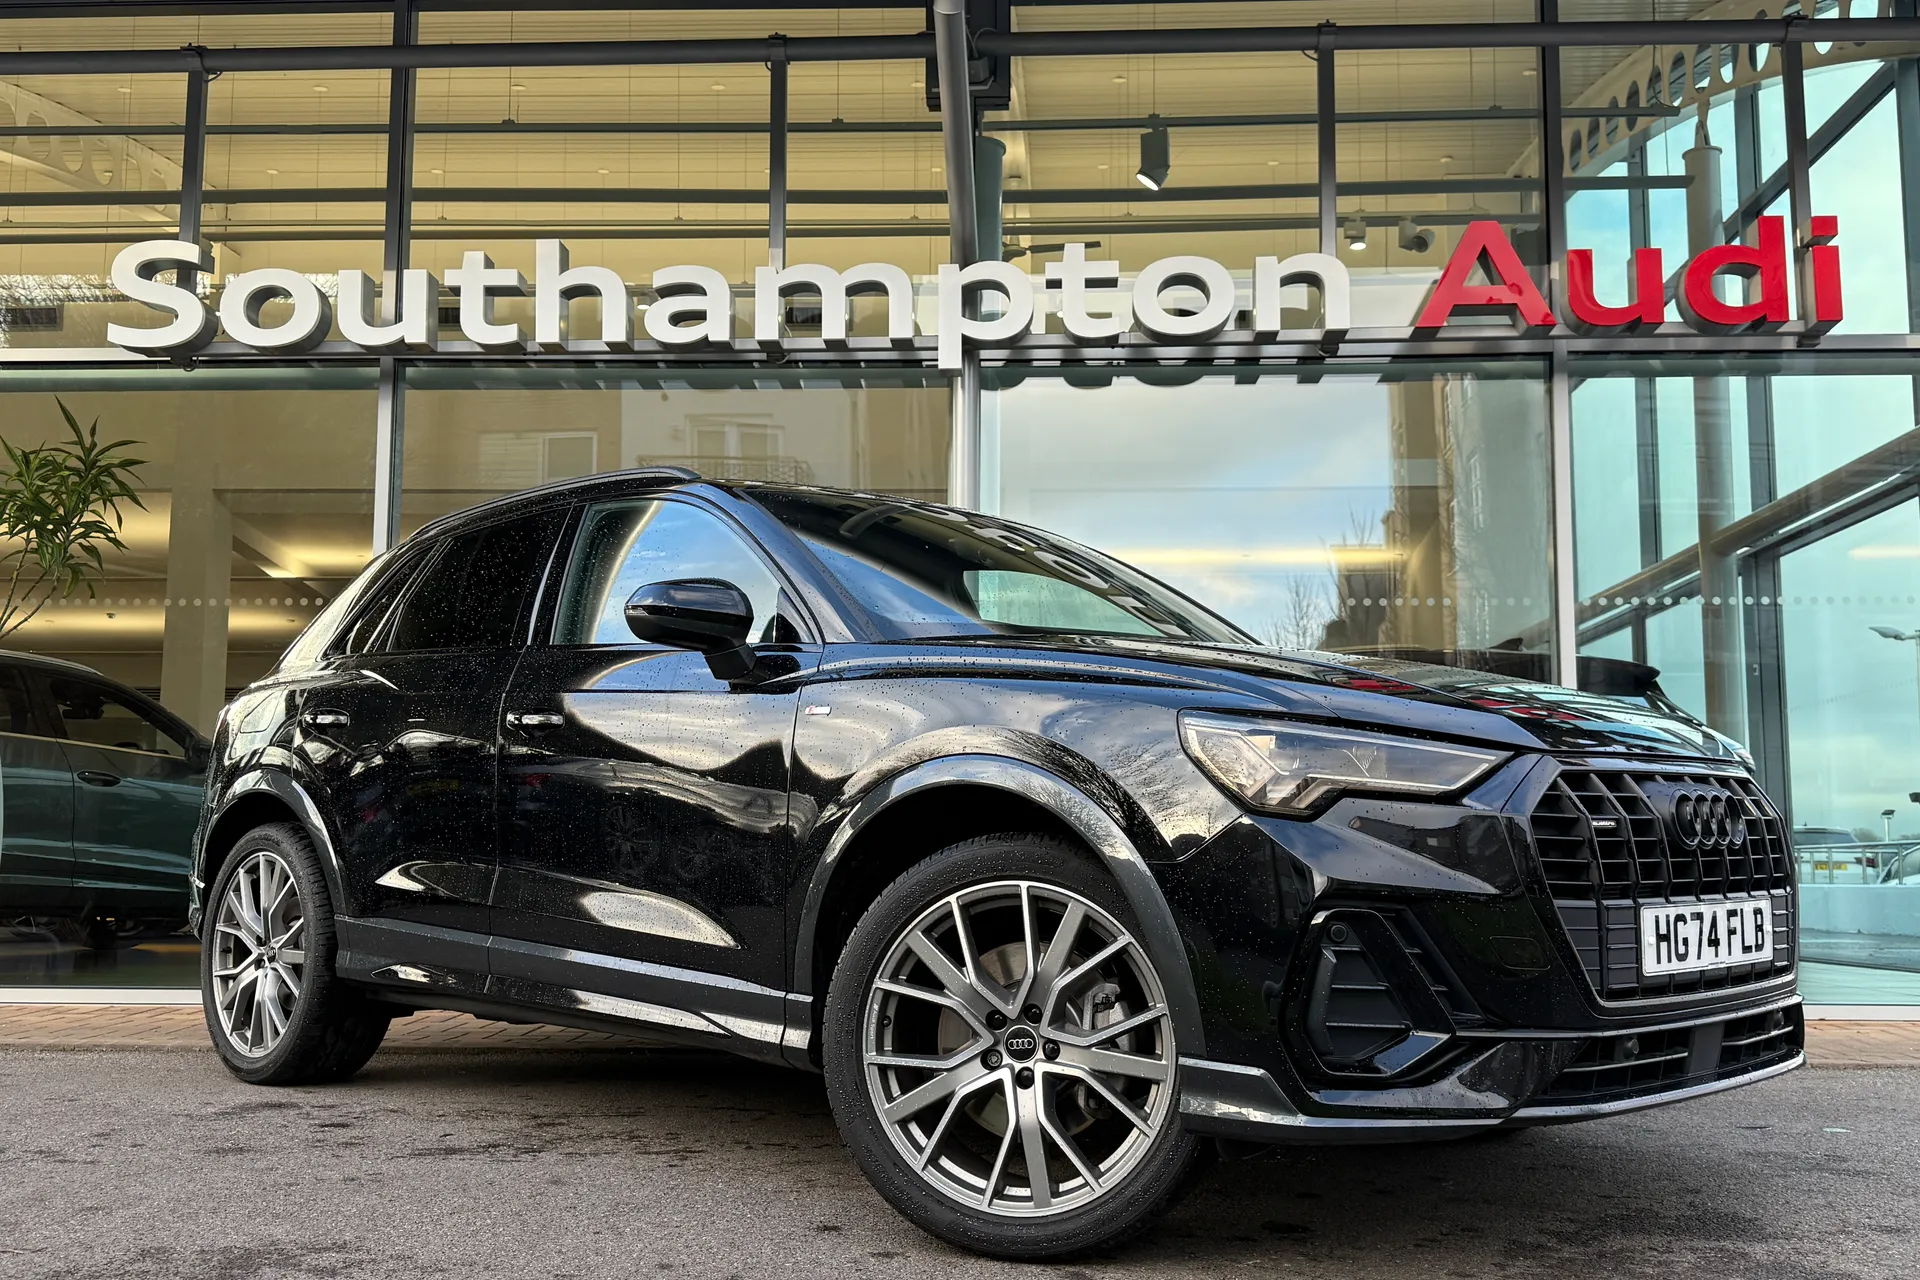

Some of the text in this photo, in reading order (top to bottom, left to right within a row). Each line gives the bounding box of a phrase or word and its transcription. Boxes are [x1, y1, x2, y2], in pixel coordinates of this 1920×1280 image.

[107, 215, 1844, 372] Southampton Audi
[1654, 907, 1765, 965] HG74 FLB
